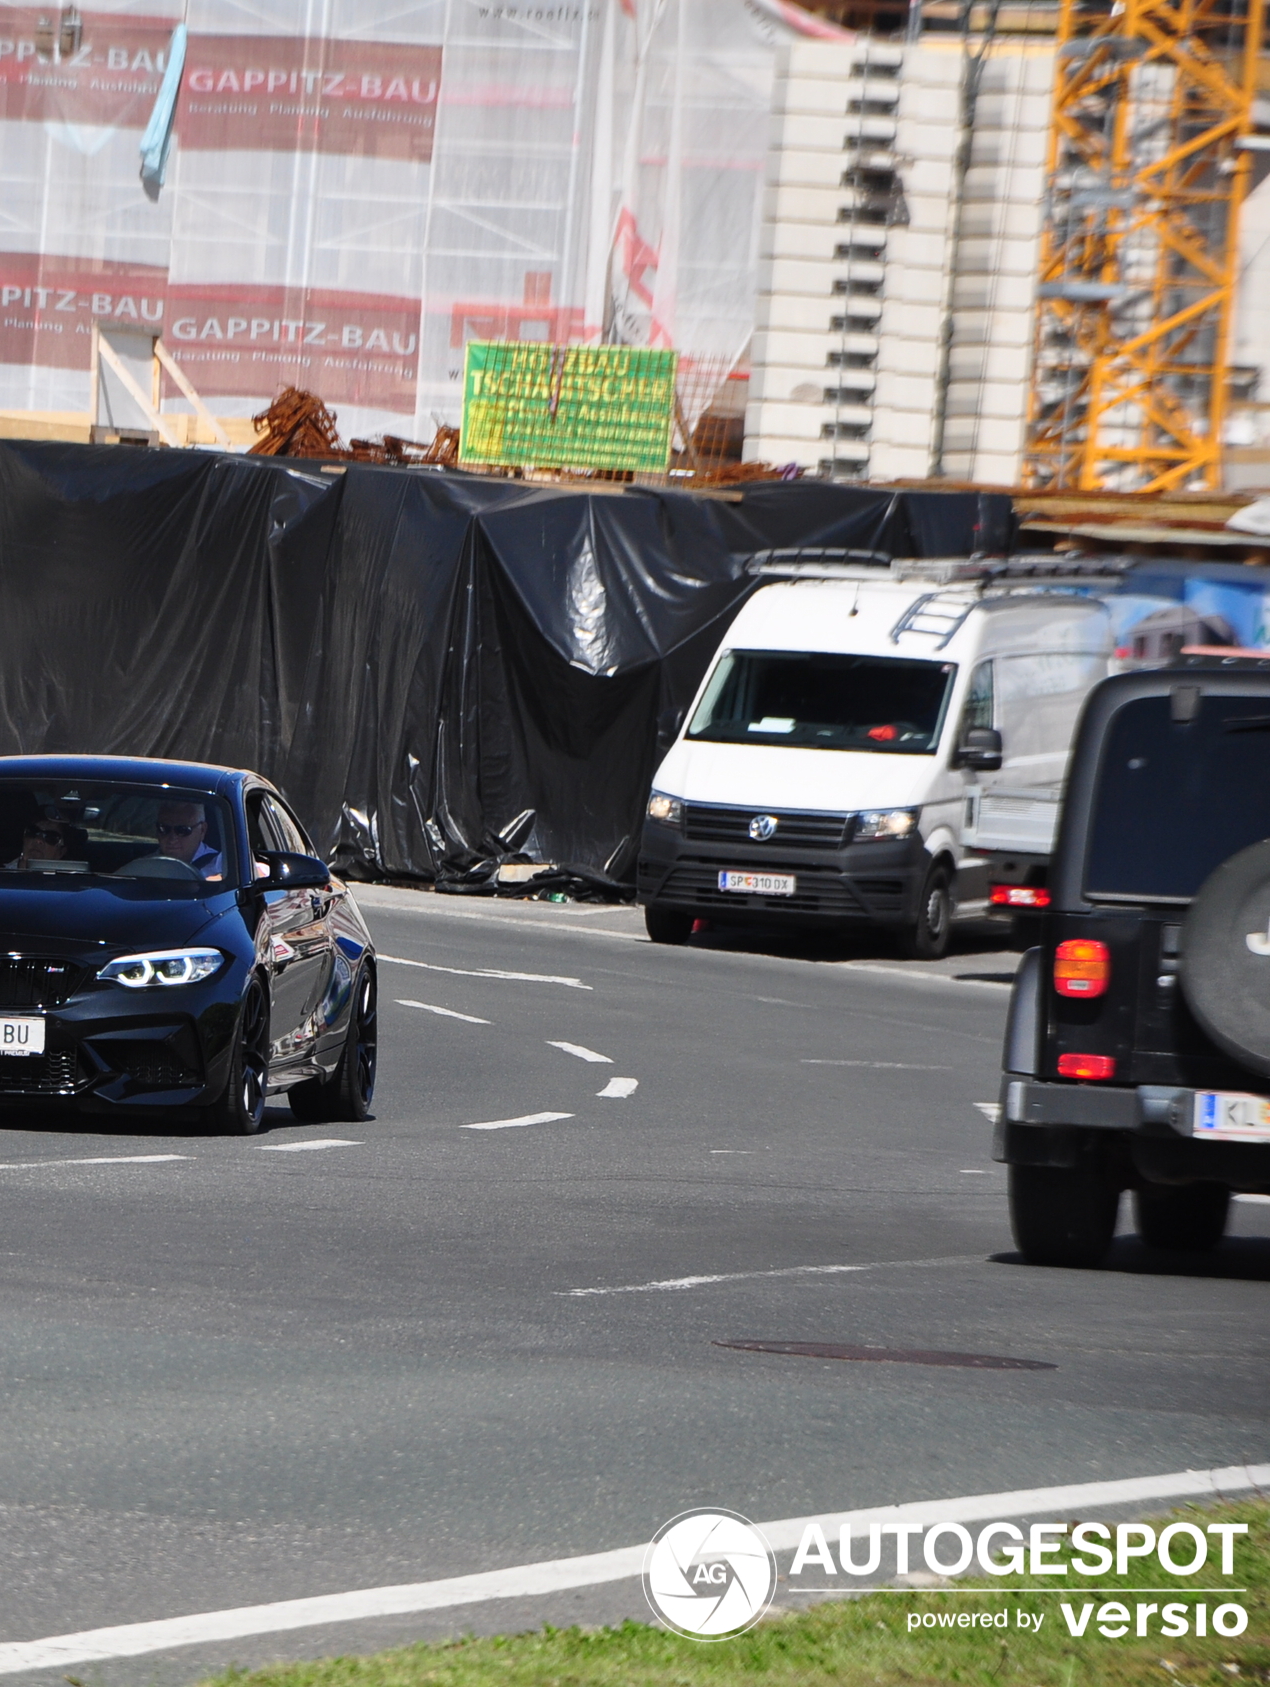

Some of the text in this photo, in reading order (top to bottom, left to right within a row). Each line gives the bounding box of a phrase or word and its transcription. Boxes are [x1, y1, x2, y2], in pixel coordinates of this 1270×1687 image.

[188, 69, 438, 104] GAPPITZ-BAU
[189, 103, 257, 116] Beratung
[270, 103, 330, 119] Planung
[4, 317, 63, 334] Planung
[172, 317, 416, 356] GAPPITZ-BAU
[252, 351, 311, 368] Planung
[730, 875, 743, 887] SP
[3, 1024, 29, 1044] BU
